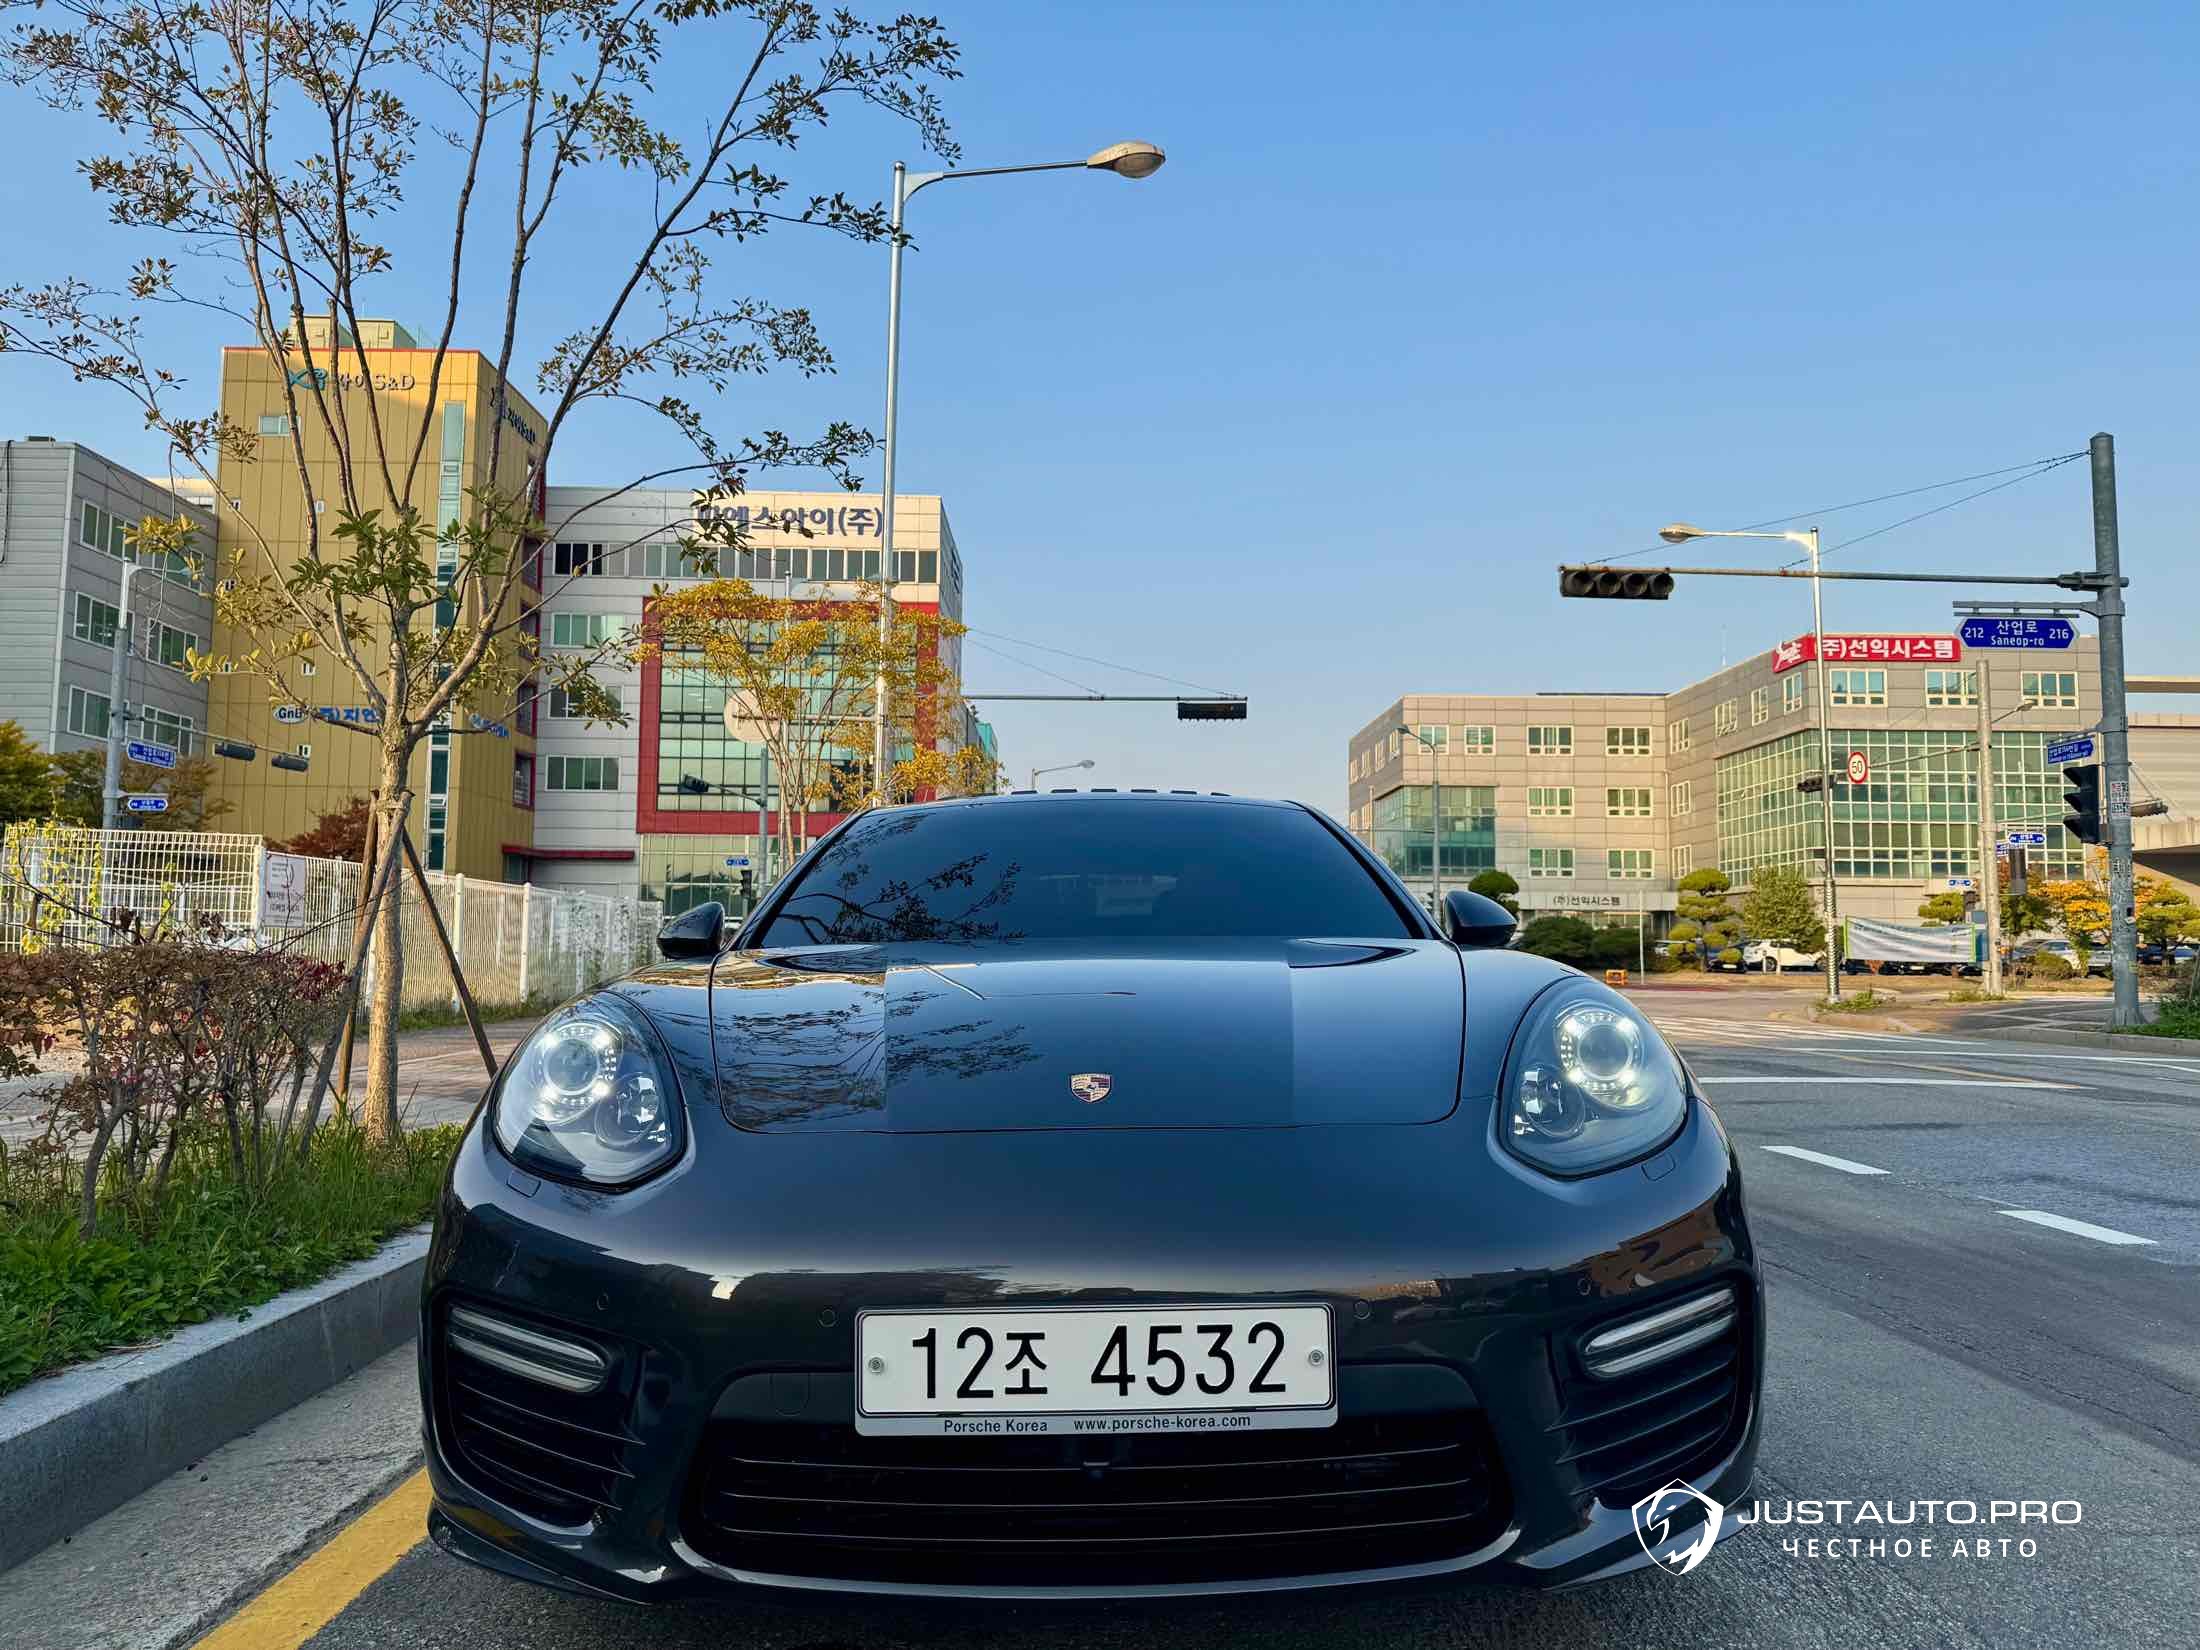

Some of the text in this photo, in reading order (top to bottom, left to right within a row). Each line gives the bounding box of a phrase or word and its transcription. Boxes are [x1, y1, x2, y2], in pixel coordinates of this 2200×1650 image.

[1964, 627, 1984, 638] 212
[1997, 620, 2038, 636] 산업로
[2049, 628, 2069, 639] 216
[1991, 635, 2045, 647] Saneop-ro
[1815, 638, 1953, 659] 주)선익시스템
[1852, 760, 1863, 774] 50
[1553, 895, 1620, 906] (주)선익시스템
[912, 1322, 1286, 1399] 12조 4532
[944, 1415, 1251, 1434] Porsche Korea www.porsche-korea.com
